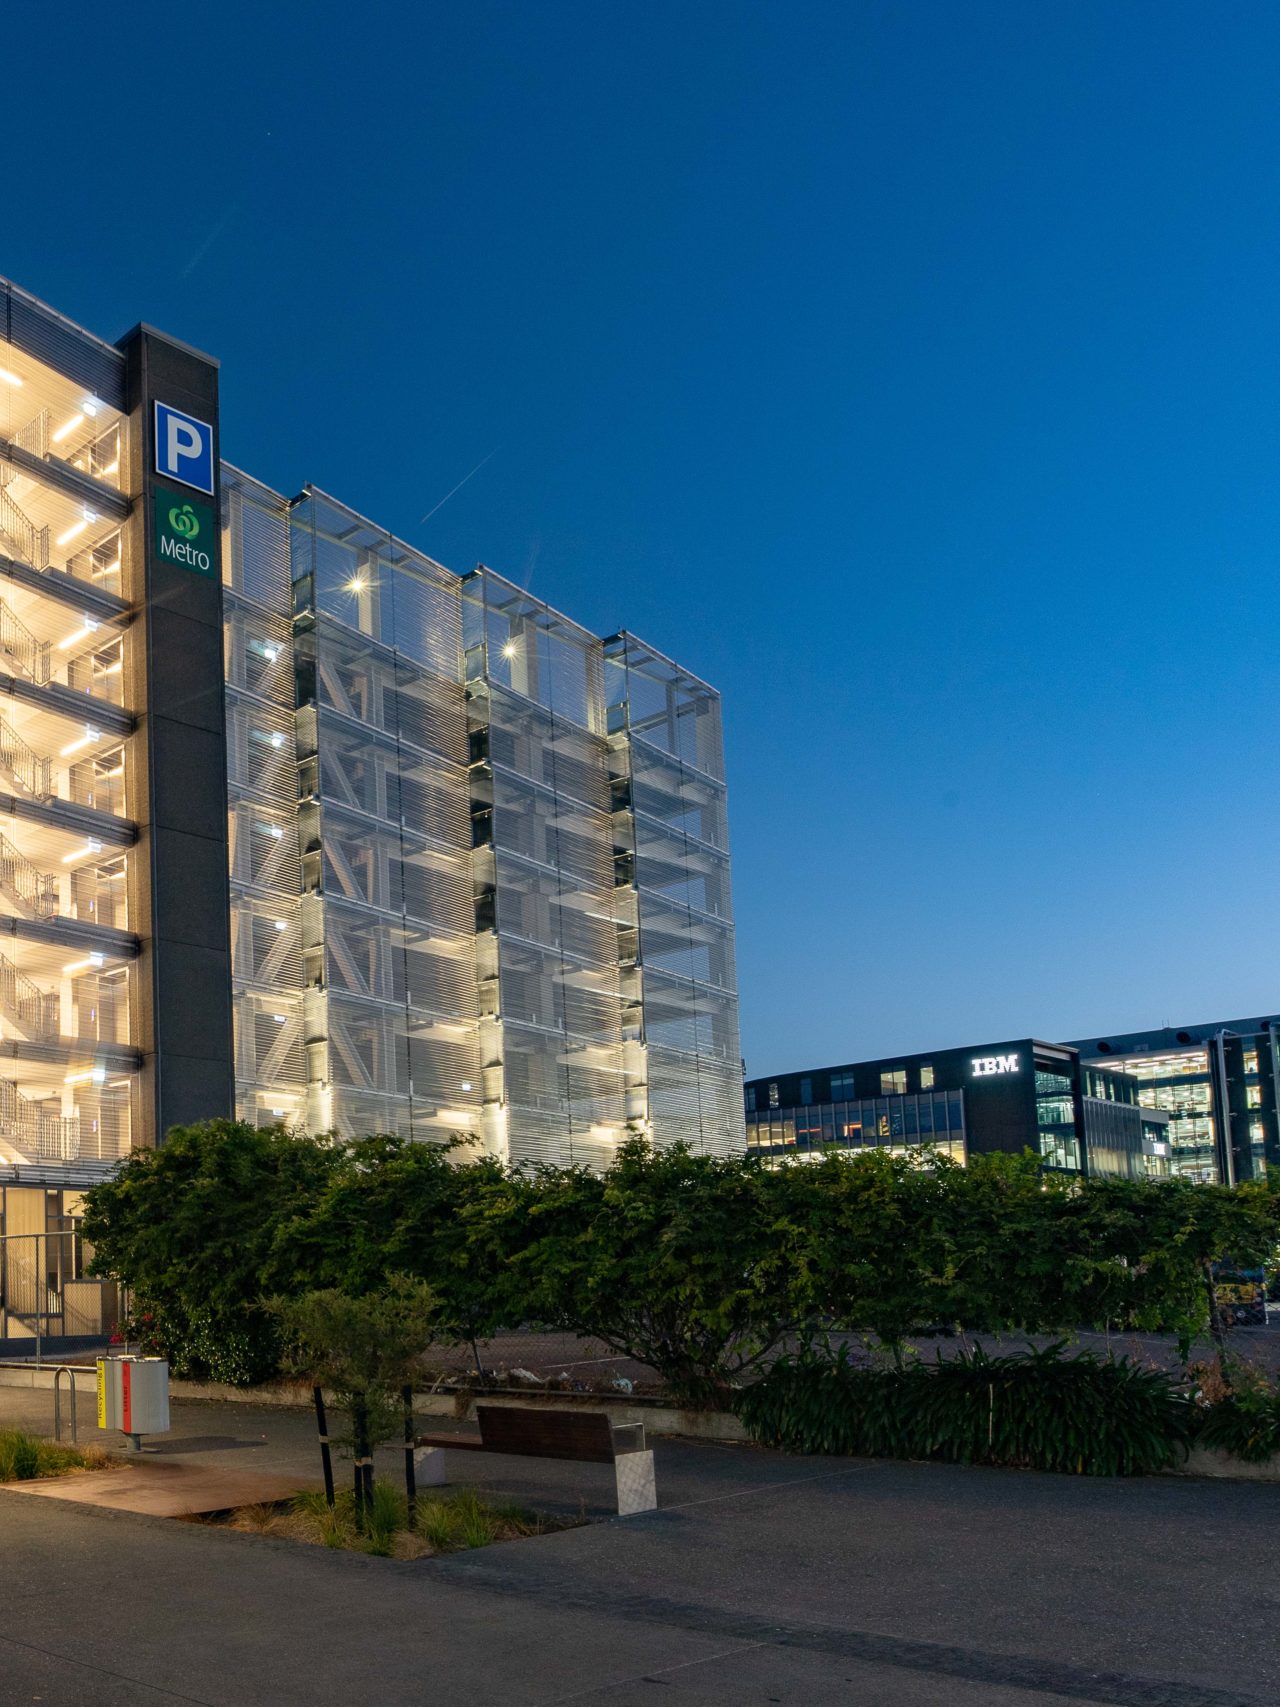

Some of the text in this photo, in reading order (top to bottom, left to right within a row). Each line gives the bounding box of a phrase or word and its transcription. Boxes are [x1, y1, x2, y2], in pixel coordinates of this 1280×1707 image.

[167, 414, 202, 473] P
[161, 535, 210, 570] Metro
[971, 1054, 1019, 1077] IBM
